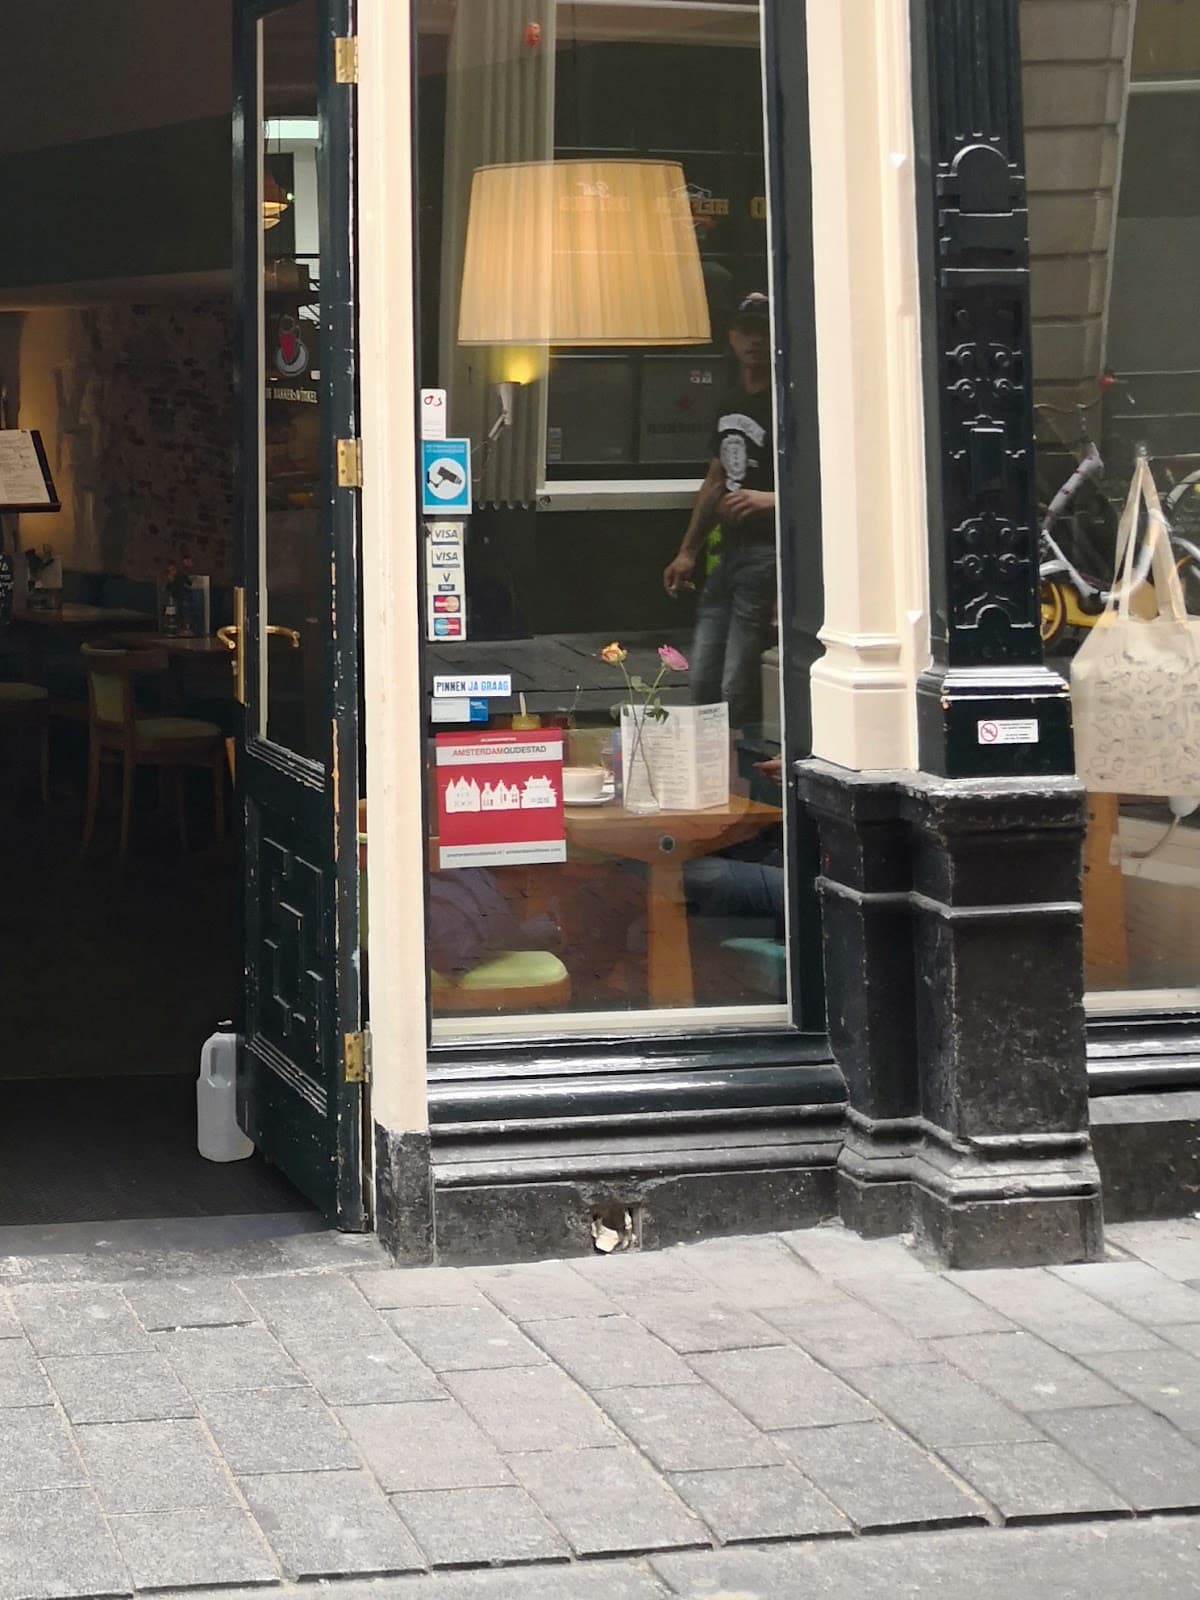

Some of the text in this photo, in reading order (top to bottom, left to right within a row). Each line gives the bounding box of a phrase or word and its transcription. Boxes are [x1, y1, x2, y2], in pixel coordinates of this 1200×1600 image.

[434, 529, 458, 538] VISA
[435, 551, 459, 561] VISA
[436, 680, 509, 692] PINNEN JA GRAAG
